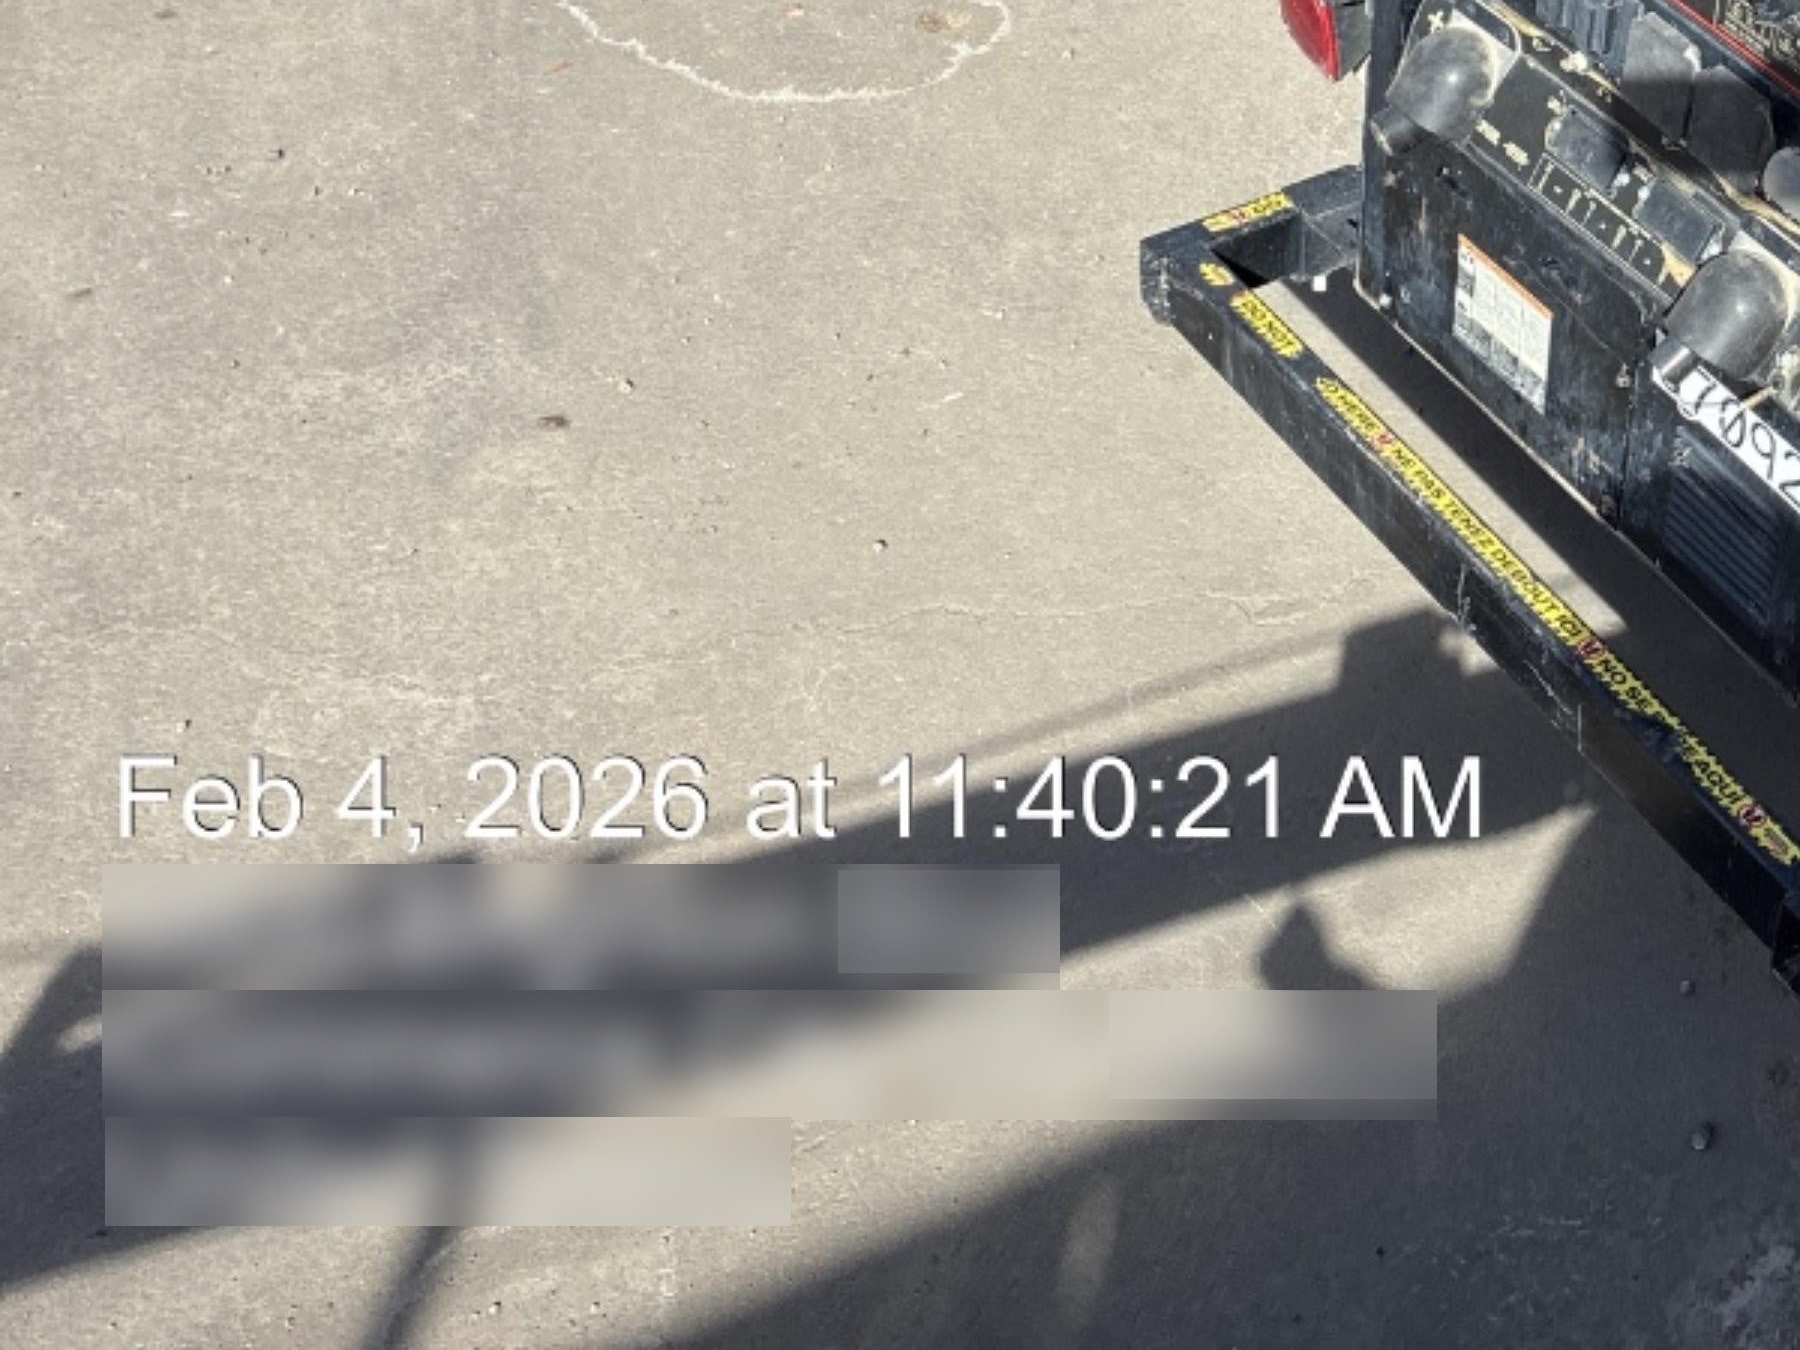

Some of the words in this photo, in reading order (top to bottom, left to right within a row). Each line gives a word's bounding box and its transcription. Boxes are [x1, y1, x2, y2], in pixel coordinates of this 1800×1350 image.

[1445, 502, 1494, 550] TENEZ
[1492, 549, 1560, 612] DEBOUT
[1599, 658, 1627, 685] NO
[1694, 758, 1746, 805] AQUI
